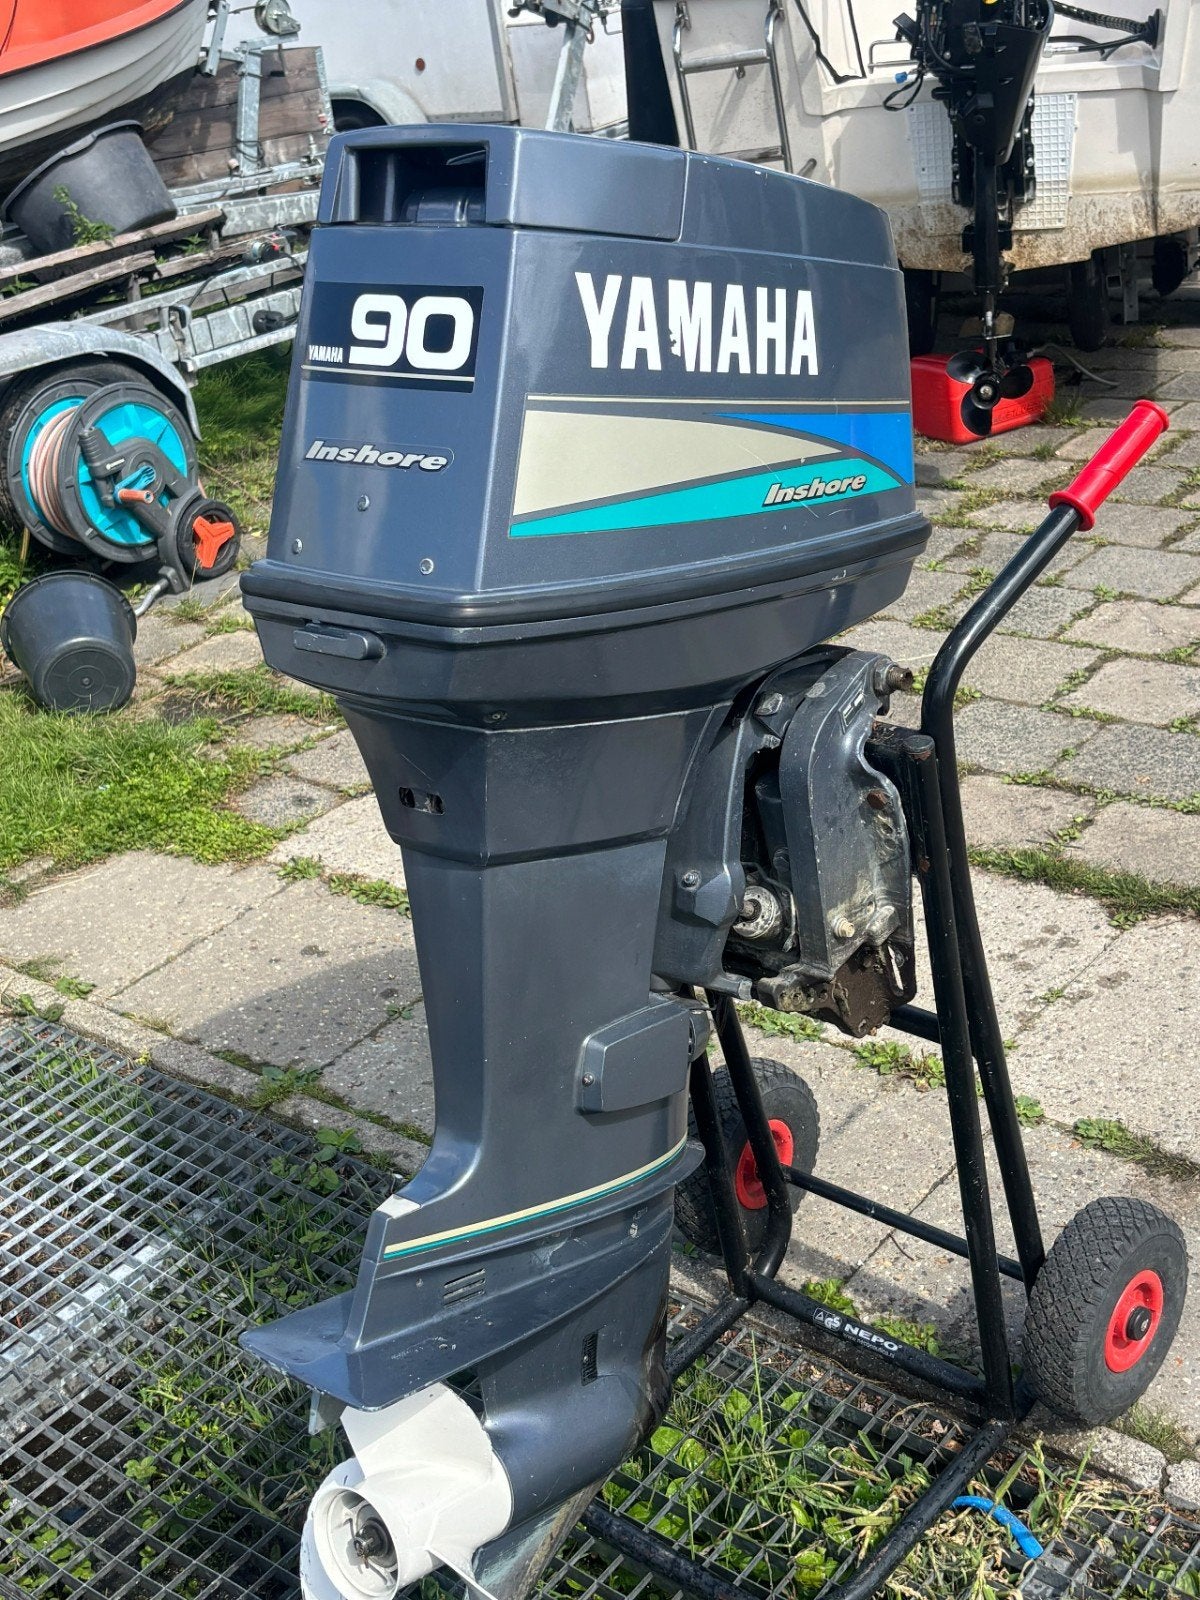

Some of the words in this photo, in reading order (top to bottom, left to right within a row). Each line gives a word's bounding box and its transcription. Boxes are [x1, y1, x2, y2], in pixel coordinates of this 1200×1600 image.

[307, 344, 344, 364] YAMAHA
[348, 293, 475, 371] 90
[574, 271, 819, 376] YAMAHA
[304, 439, 449, 472] Inshore
[761, 474, 868, 507] Inshore
